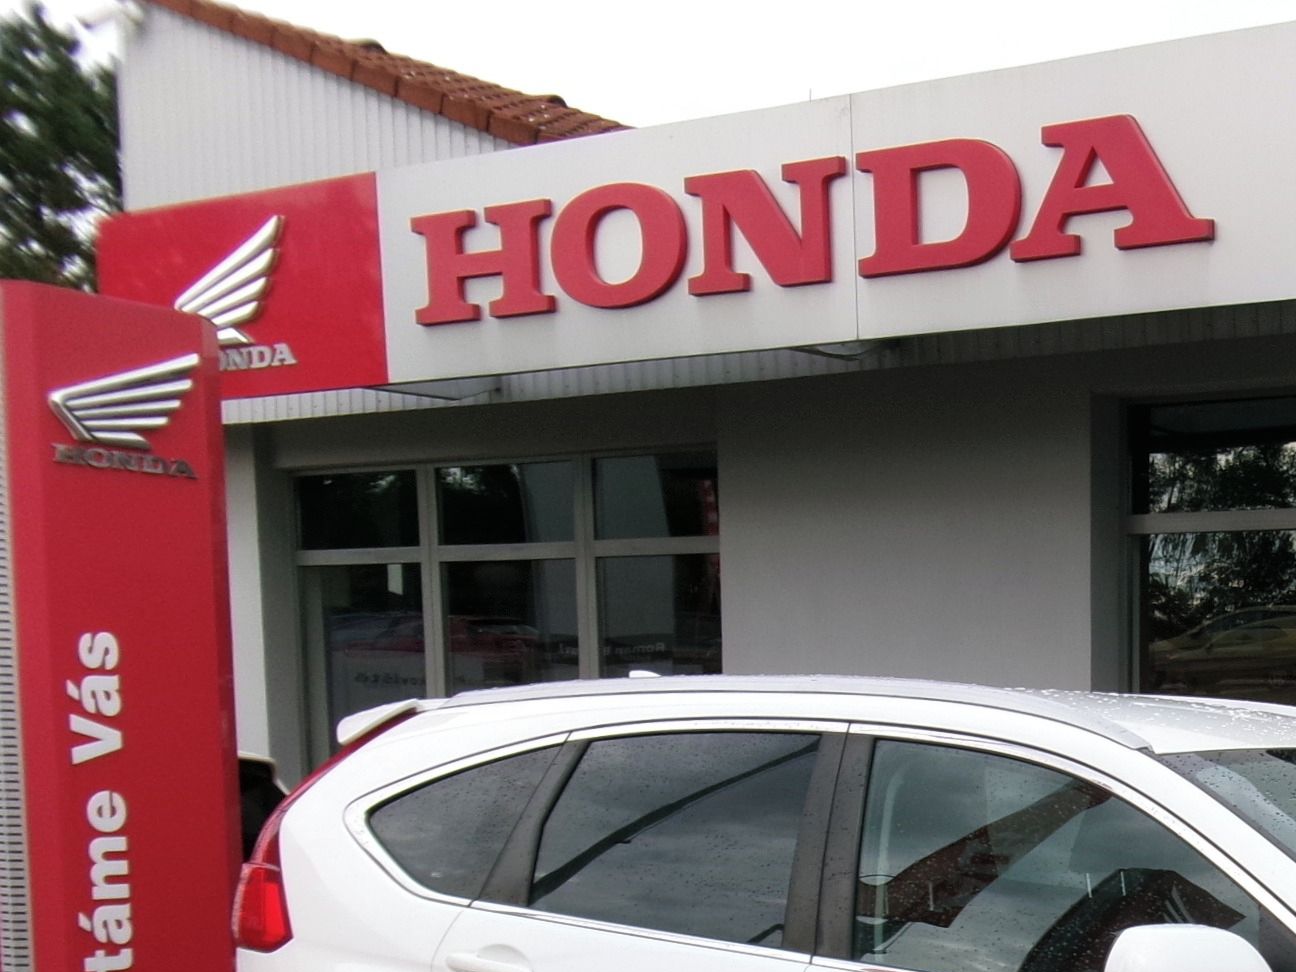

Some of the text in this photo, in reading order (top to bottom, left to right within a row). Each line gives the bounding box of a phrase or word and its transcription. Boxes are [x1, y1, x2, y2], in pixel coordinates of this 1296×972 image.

[411, 114, 1216, 326] HONDA
[218, 343, 297, 371] NDA
[52, 443, 197, 479] HONDA
[66, 631, 125, 765] Vás
